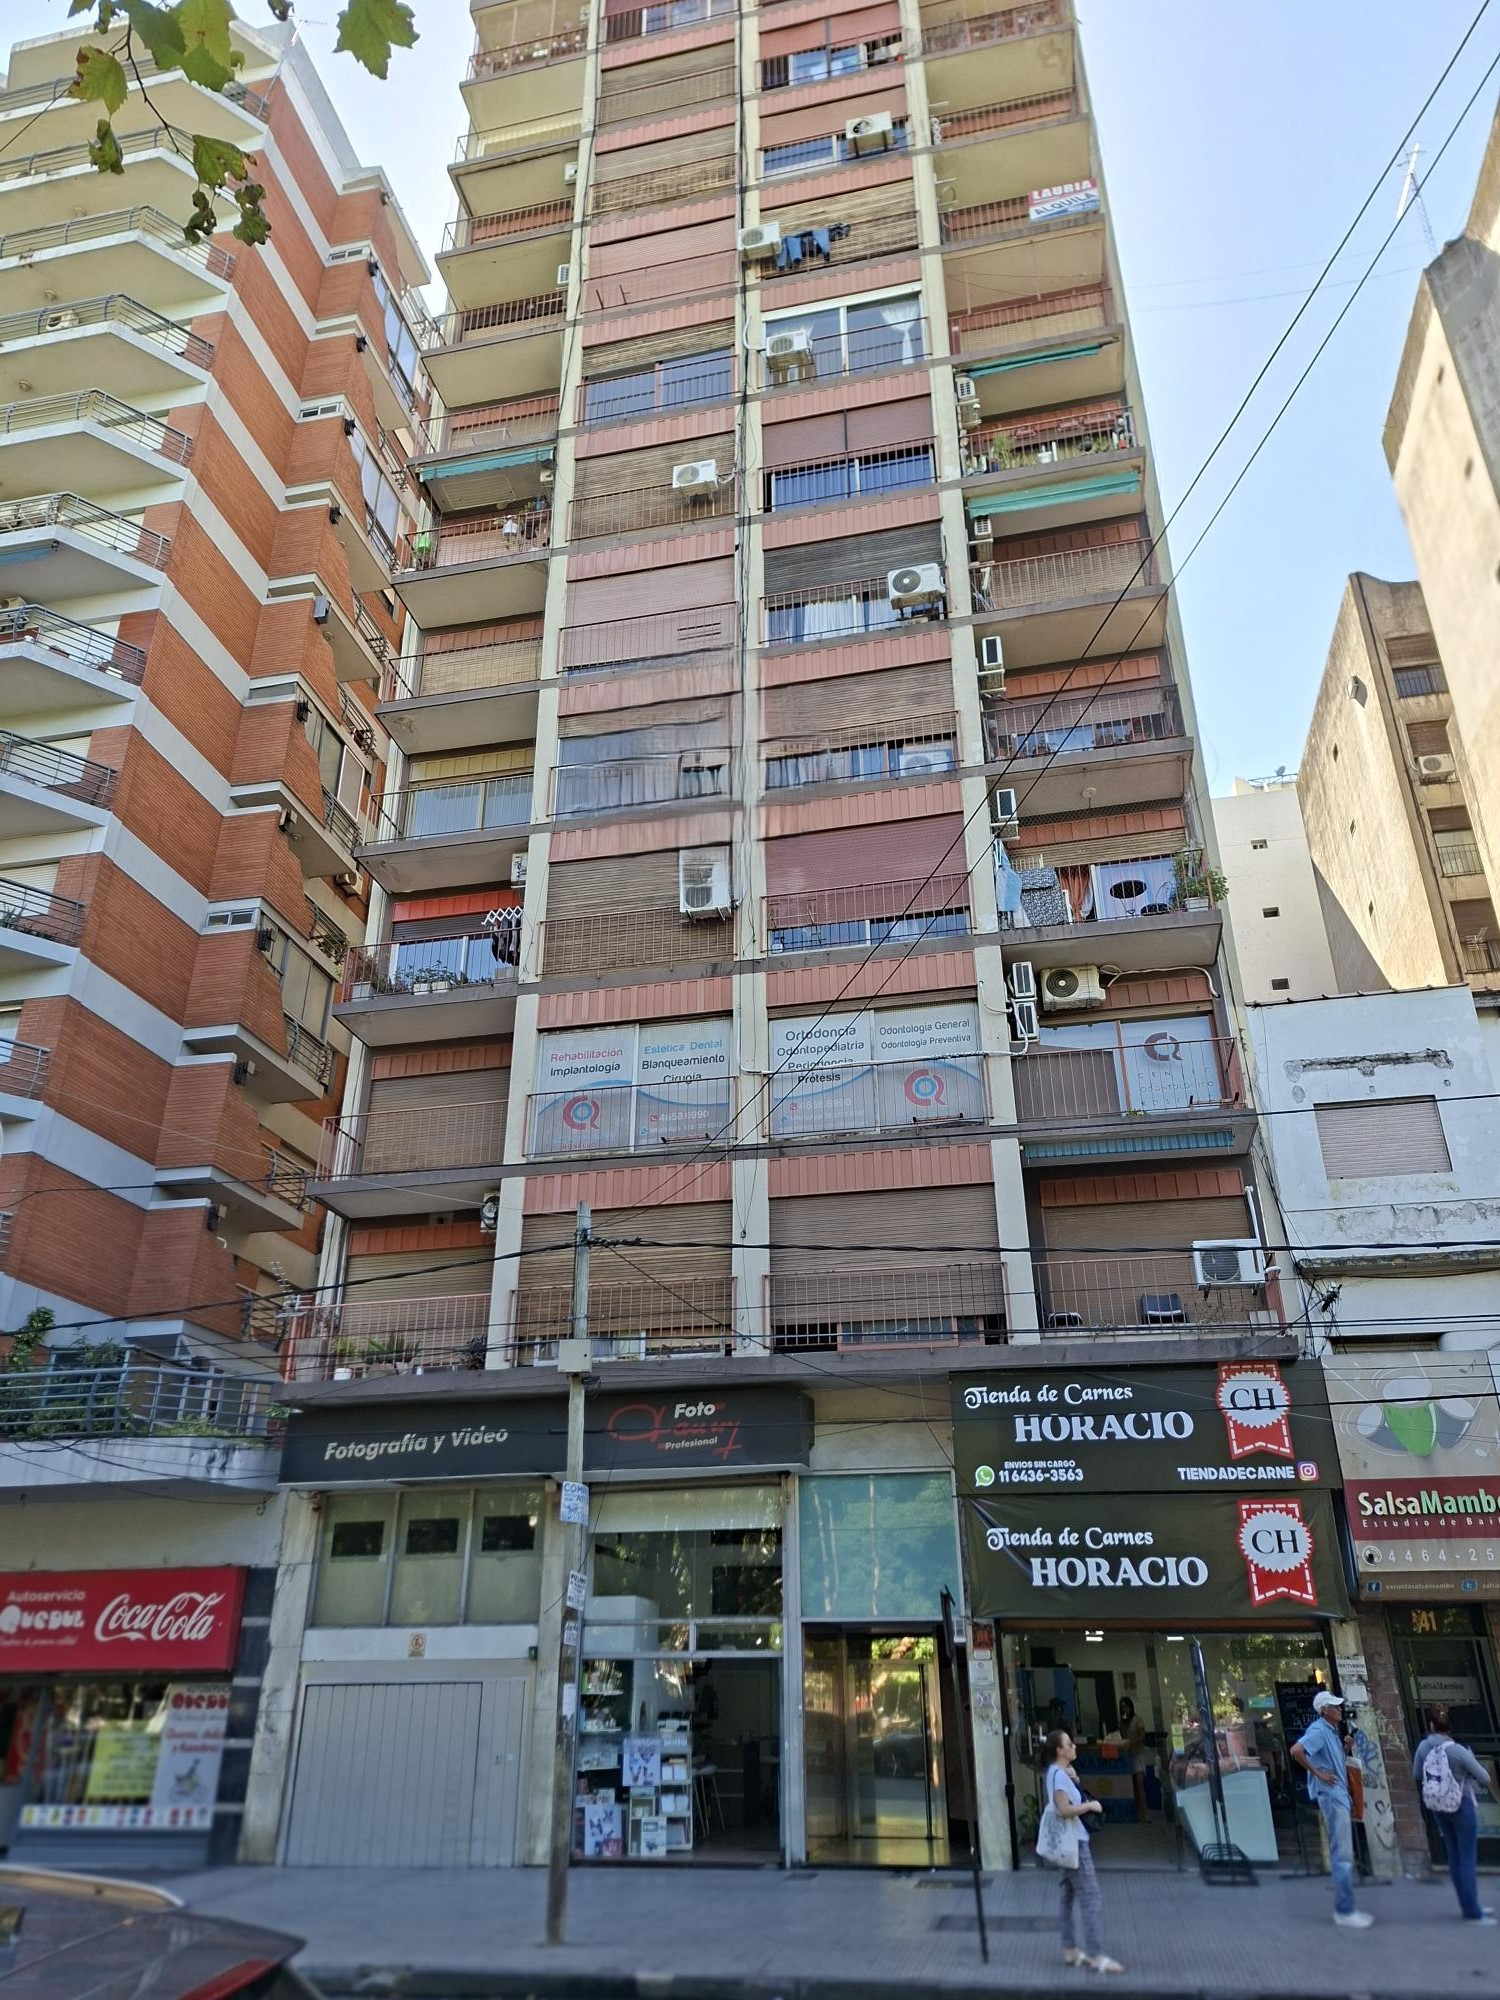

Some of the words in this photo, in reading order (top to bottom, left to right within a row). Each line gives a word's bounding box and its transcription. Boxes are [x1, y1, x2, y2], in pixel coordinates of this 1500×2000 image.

[1032, 180, 1092, 200] LAURIA
[1034, 192, 1096, 215] ALQUILA
[935, 1018, 970, 1030] General
[785, 1026, 856, 1041] Ortodoncia
[929, 1034, 971, 1045] Preventiva
[550, 1048, 623, 1062] Rehabilitación
[644, 1042, 685, 1055] Estética
[690, 1039, 723, 1051] Dental
[642, 1053, 725, 1070] Blanqueamiento
[797, 1072, 841, 1084] Prótesis
[964, 1384, 1032, 1409] Tienda
[1037, 1384, 1058, 1403] de
[1064, 1384, 1133, 1405] Carnes
[1229, 1387, 1276, 1411] CH
[674, 1401, 716, 1419] Foto
[1013, 1411, 1194, 1443] HORACIO
[324, 1432, 428, 1461] Fotografía
[433, 1434, 446, 1454] y
[451, 1425, 509, 1447] Video
[664, 1436, 718, 1450] Profesional
[1004, 1461, 1032, 1469] ENVIOS
[1034, 1461, 1046, 1469] SIN
[1047, 1460, 1076, 1468] CARGO
[999, 1470, 1010, 1483] 11
[1011, 1468, 1084, 1483] 6436-3563
[1177, 1466, 1296, 1481] TIENDADECARNE
[1358, 1488, 1500, 1517] SalsaMamb
[1362, 1517, 1430, 1528] Estudio
[1440, 1517, 1457, 1526] de
[986, 1527, 1053, 1550] Tienda
[1058, 1527, 1080, 1546] de
[1085, 1527, 1154, 1549] Carnes
[1251, 1529, 1301, 1555] CH
[1030, 1556, 1209, 1588] HORACIO
[6, 1589, 86, 1603] Autoservicio
[94, 1591, 226, 1642] Coca-Cola
